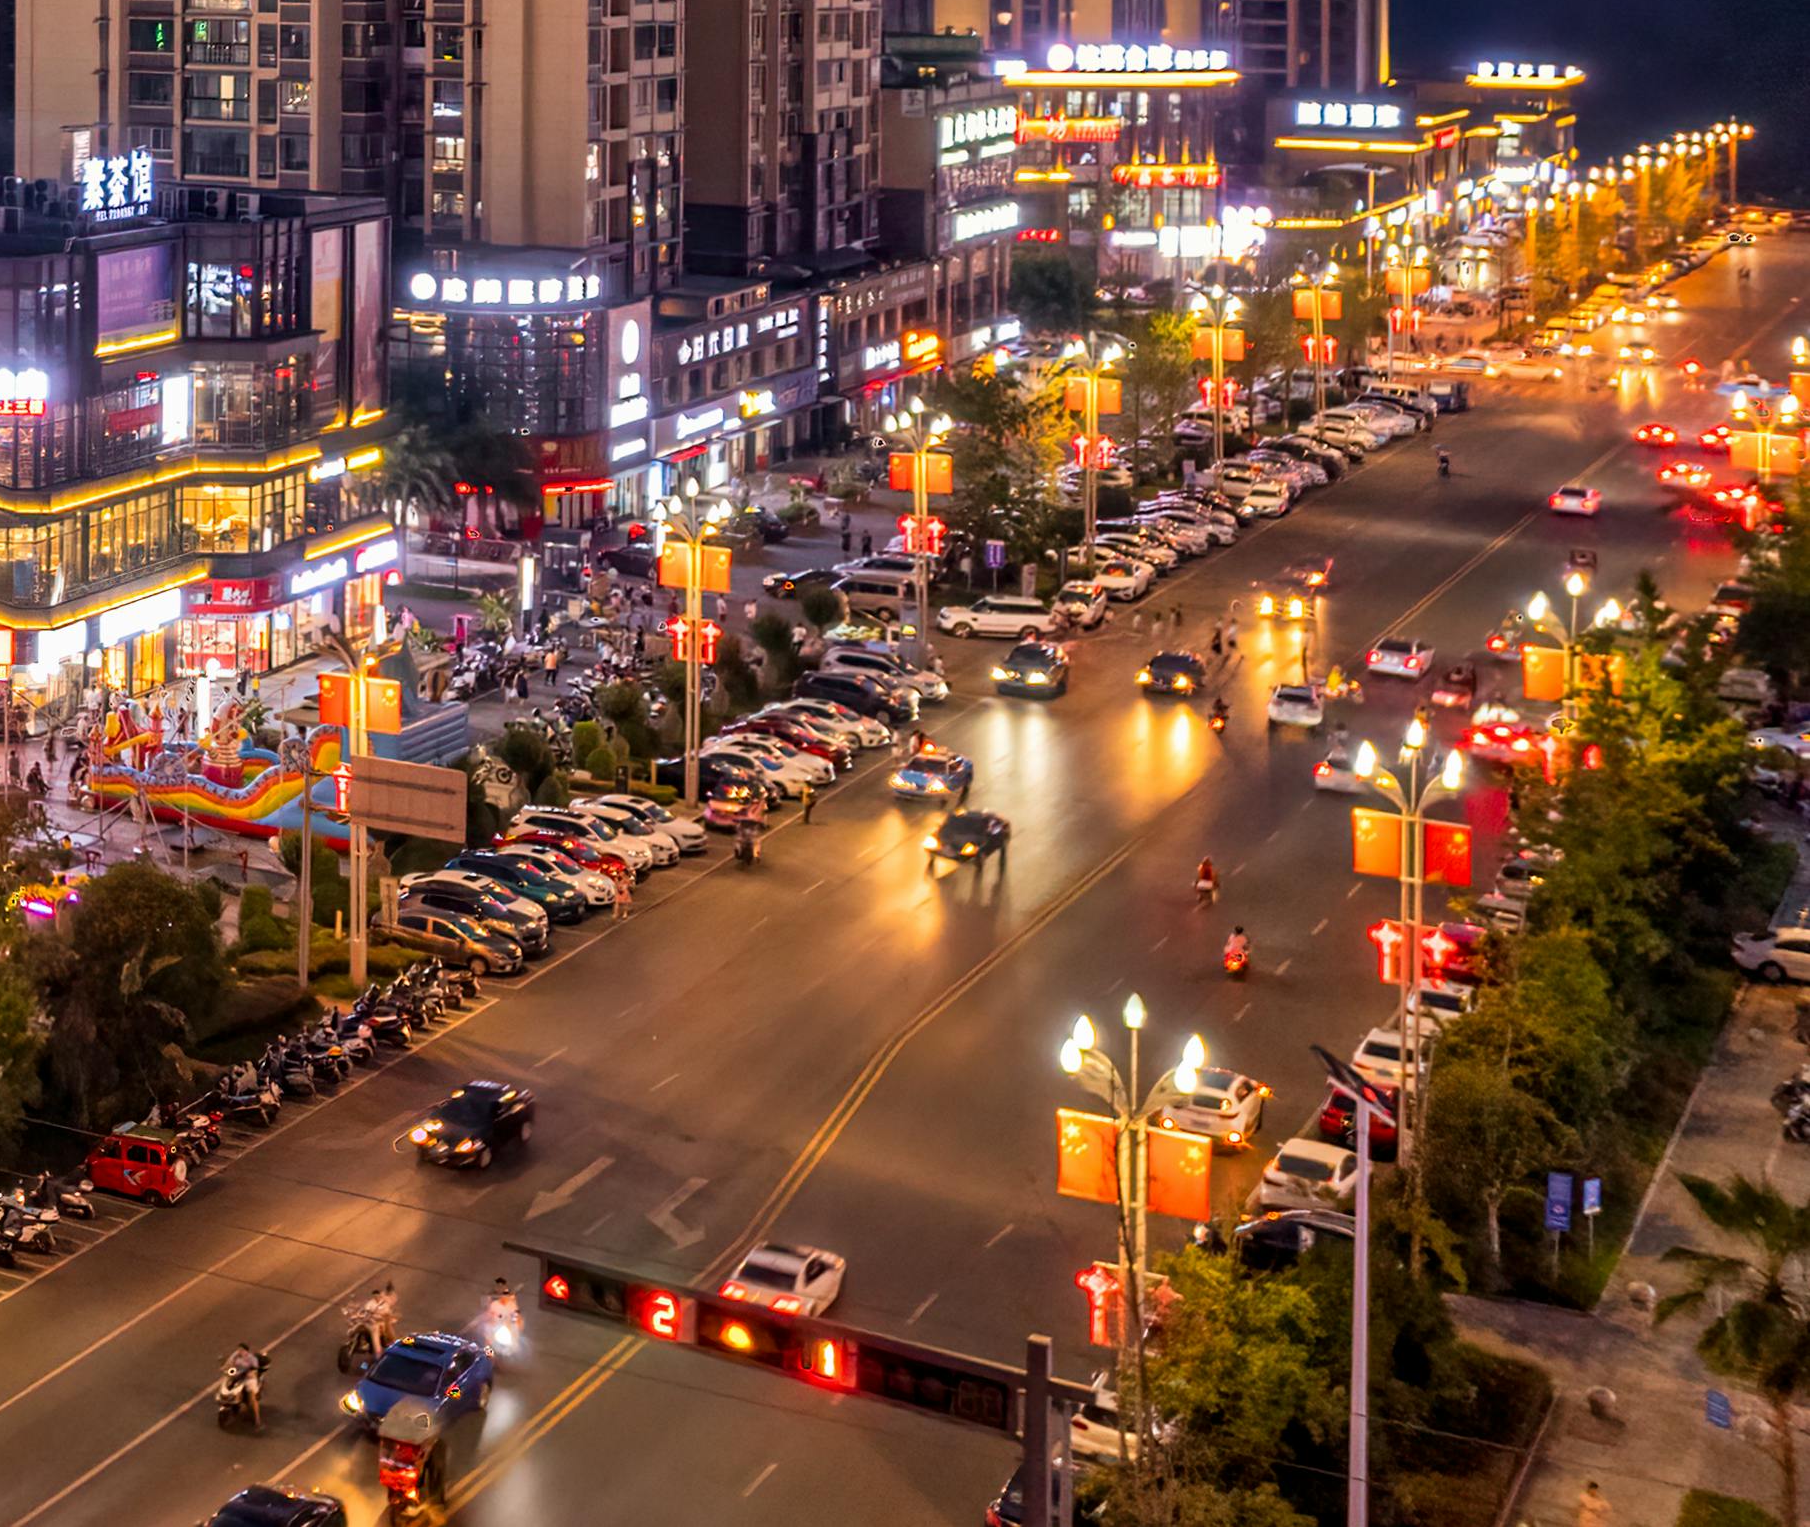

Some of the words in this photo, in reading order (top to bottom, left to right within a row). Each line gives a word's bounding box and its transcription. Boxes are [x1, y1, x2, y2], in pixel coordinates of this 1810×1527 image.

[82, 149, 153, 211] 素茶馆
[650, 1292, 677, 1337] 2
